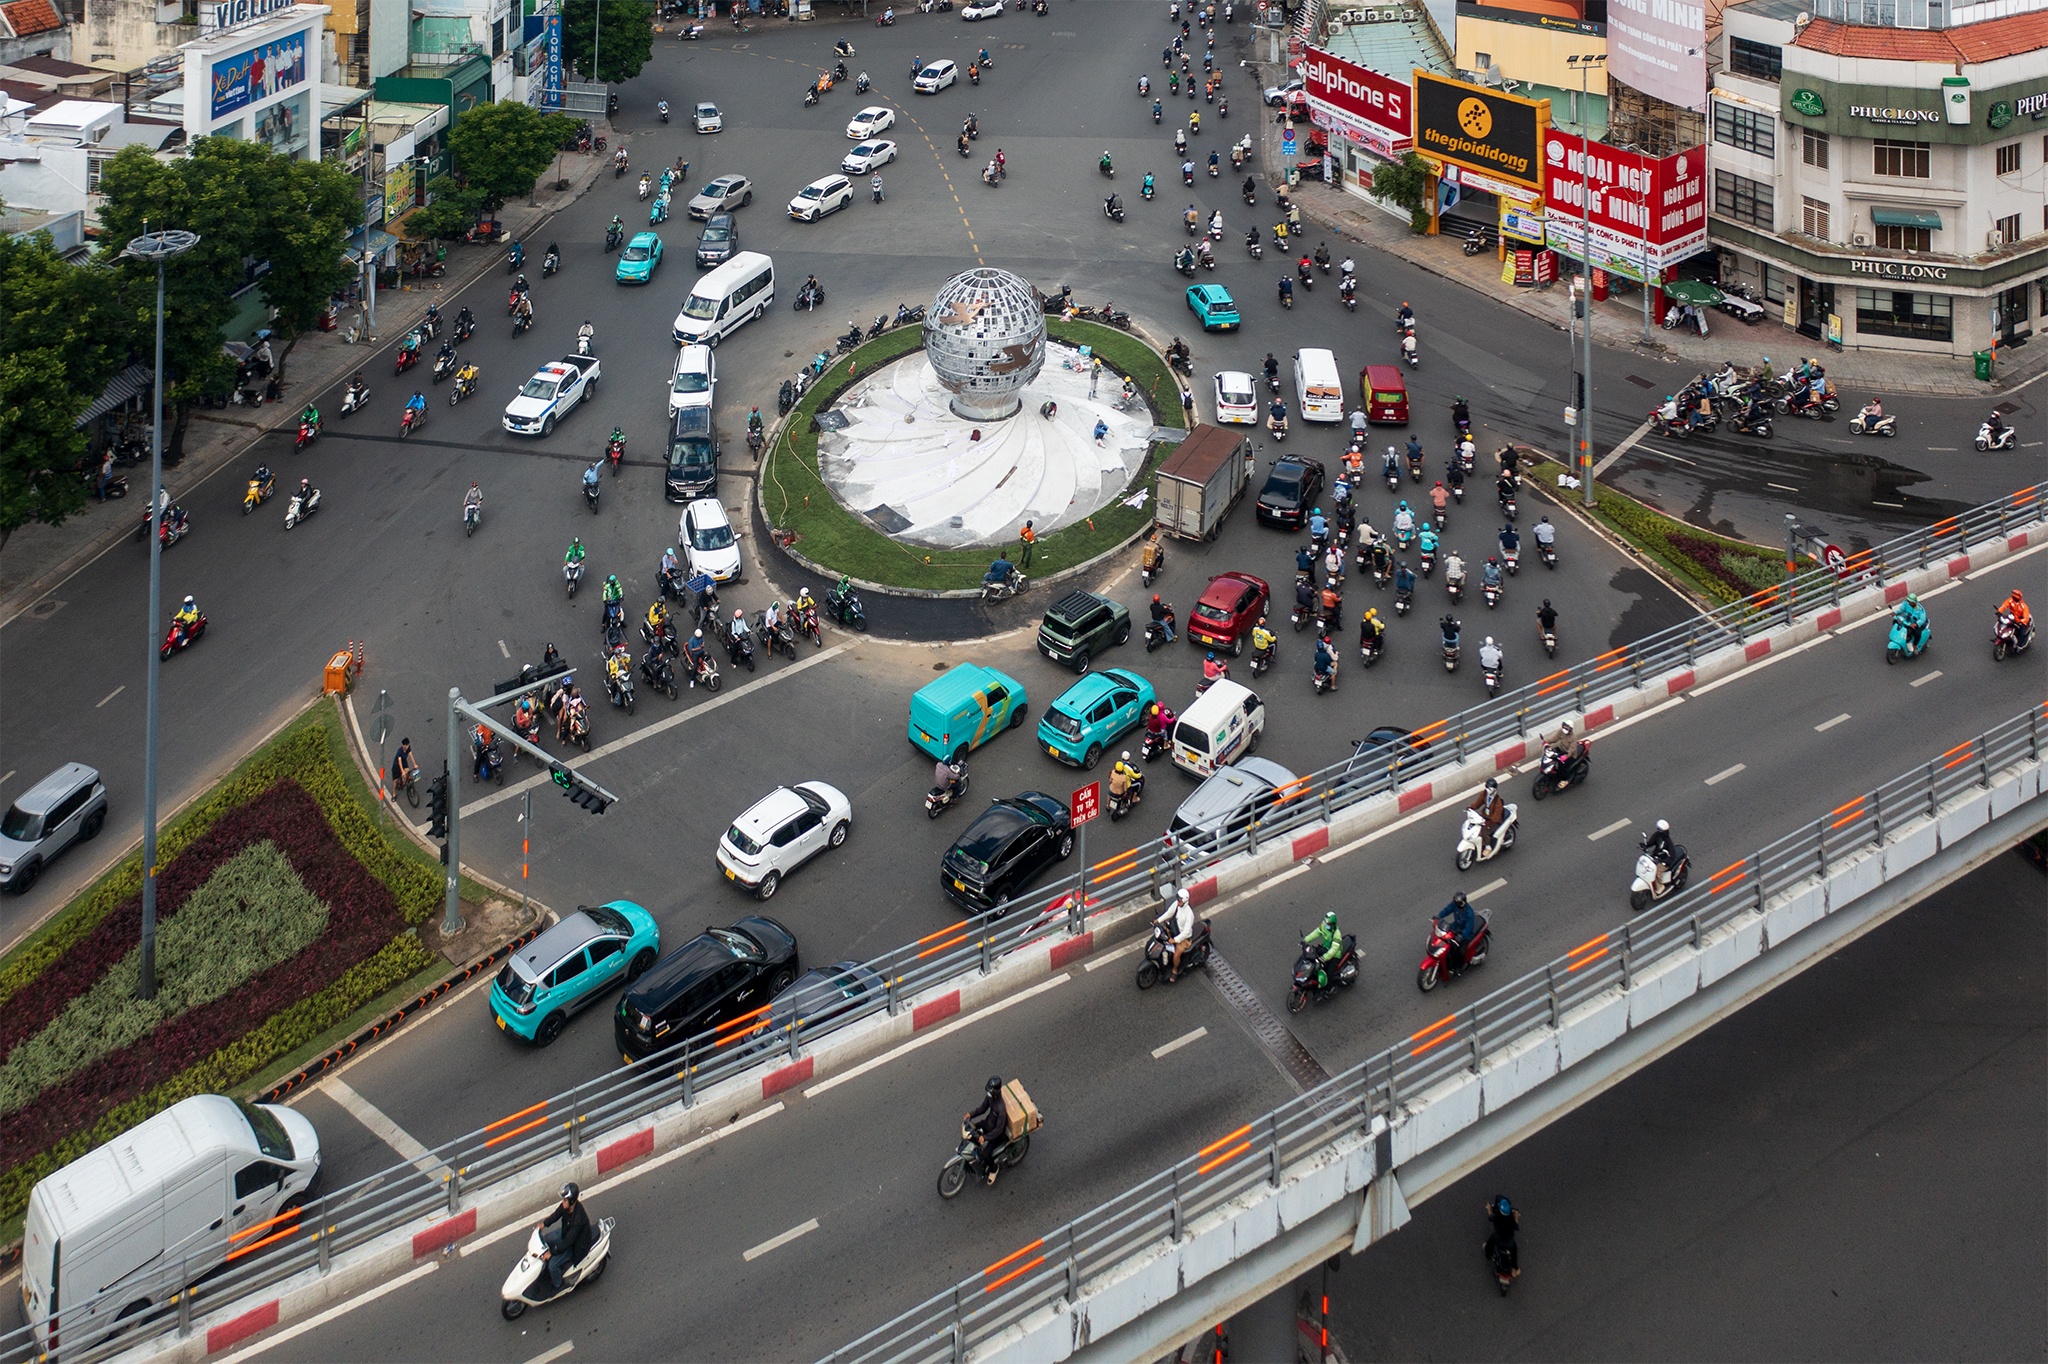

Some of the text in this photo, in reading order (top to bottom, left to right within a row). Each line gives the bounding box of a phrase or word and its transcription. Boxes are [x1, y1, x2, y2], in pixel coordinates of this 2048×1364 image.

[550, 28, 559, 102] LONG CHÂU
[1850, 105, 1940, 123] PHUC LONG
[1425, 127, 1529, 173] thegioididong
[1567, 149, 1613, 185] NGOẠI
[1663, 186, 1684, 207] NGOẠI
[1608, 195, 1650, 231] MINH
[1850, 260, 1948, 280] PHUC LONG
[1079, 787, 1092, 802] CẤM
